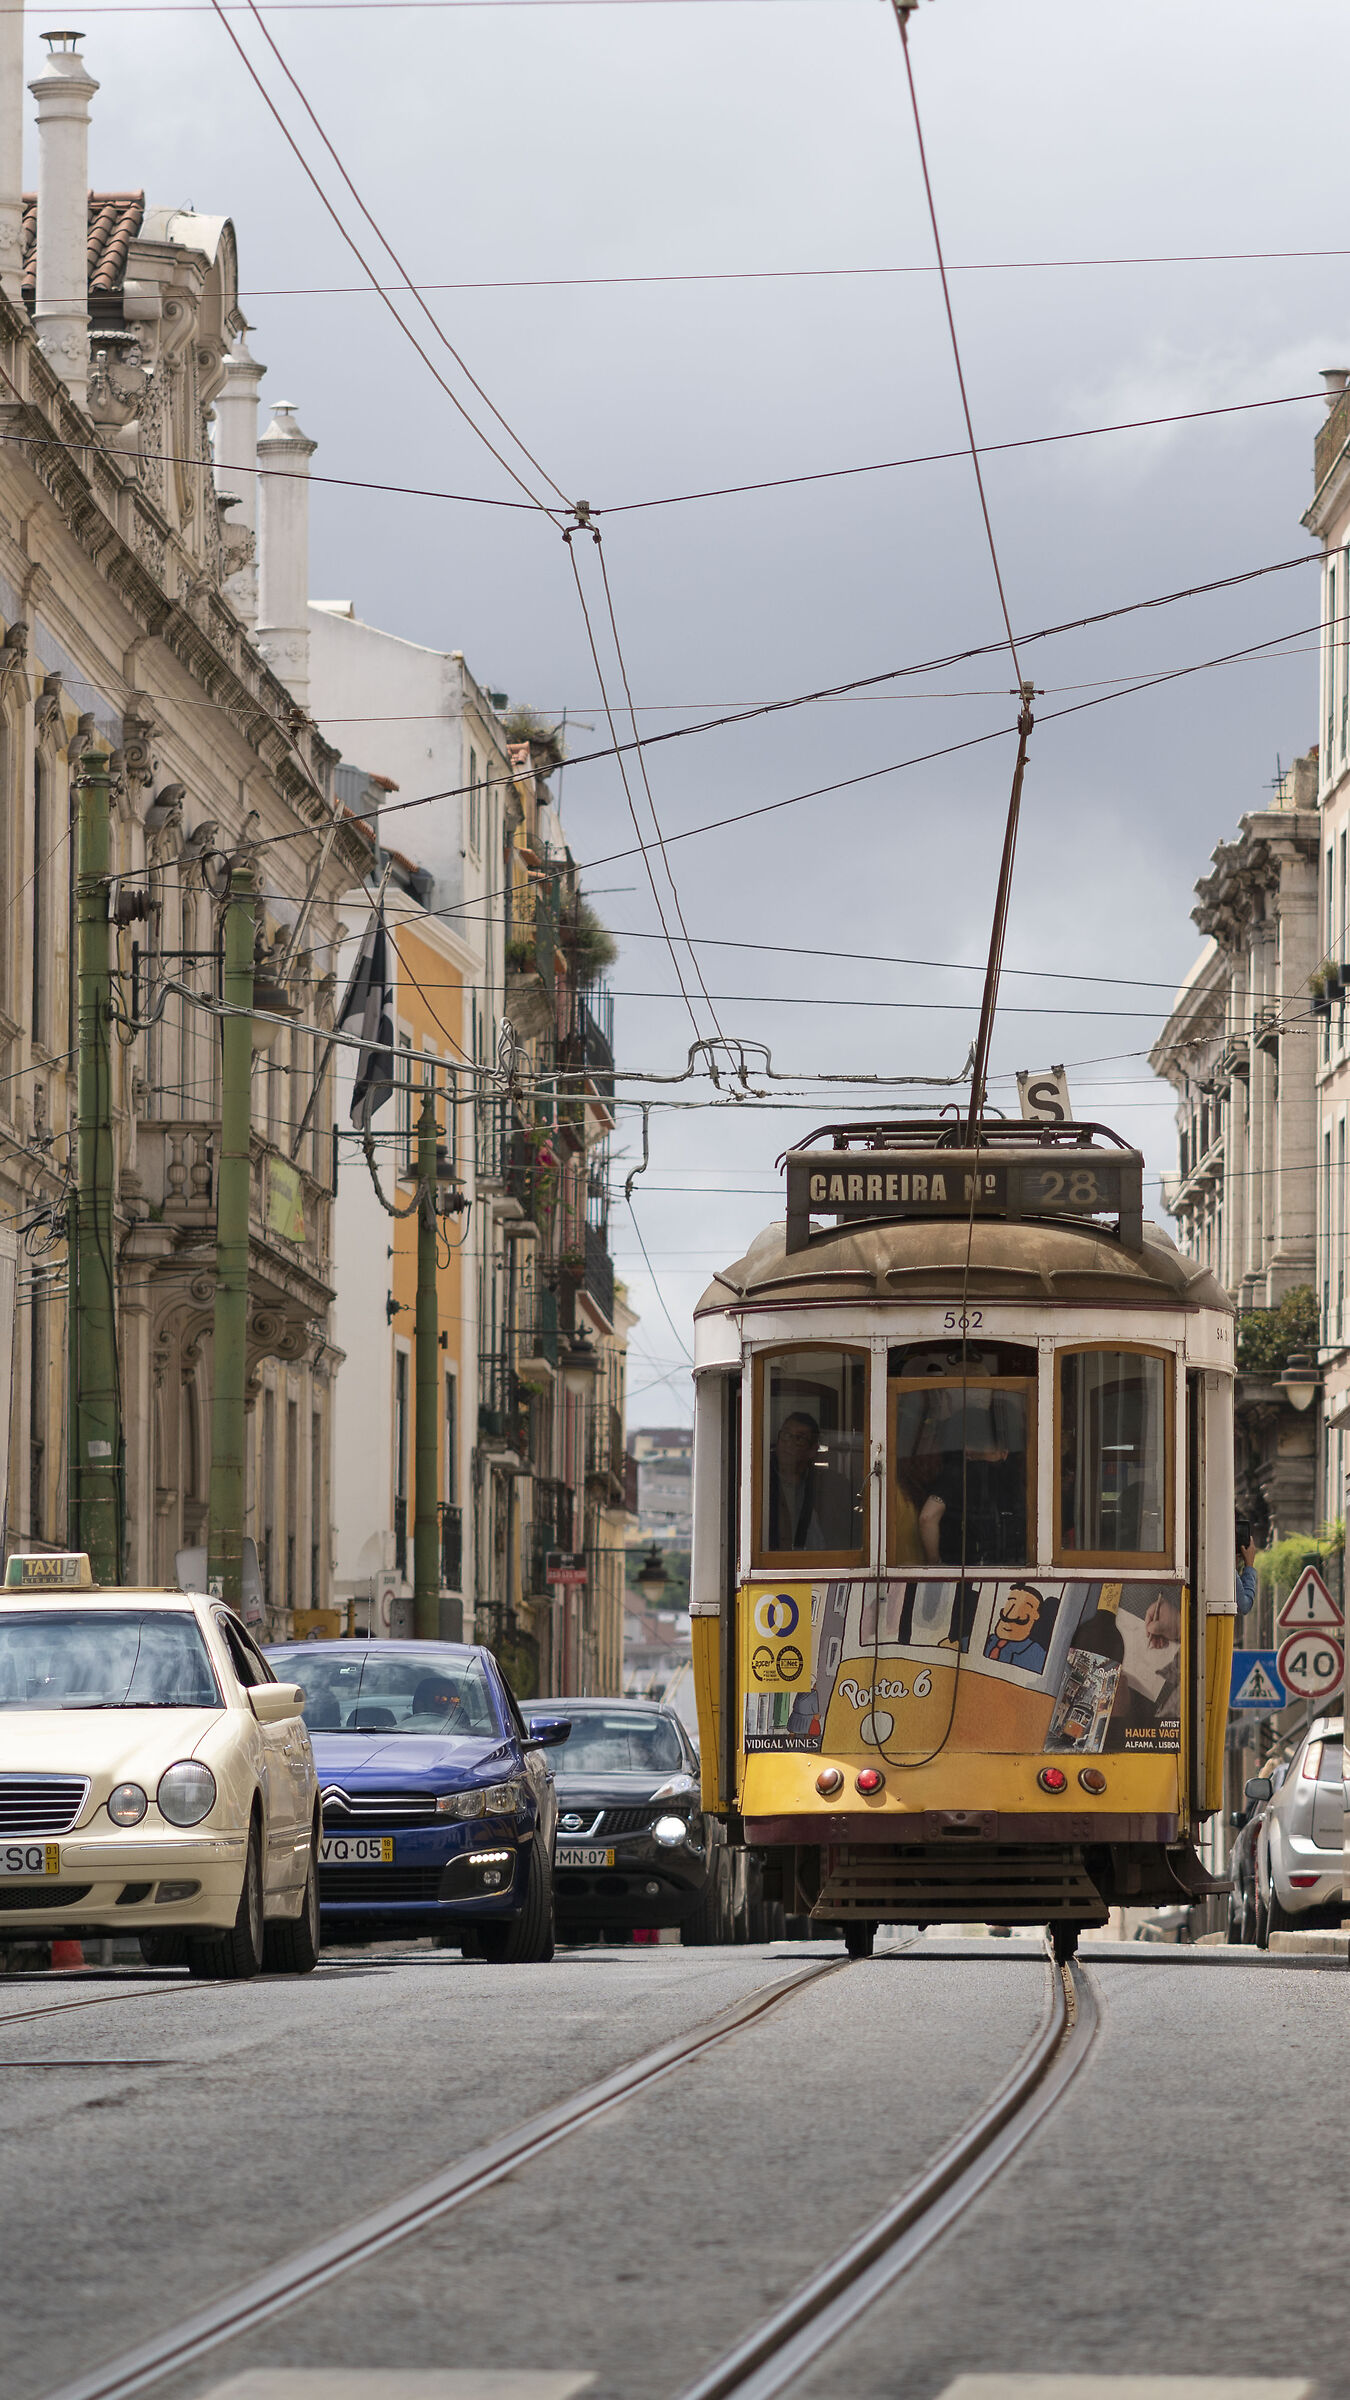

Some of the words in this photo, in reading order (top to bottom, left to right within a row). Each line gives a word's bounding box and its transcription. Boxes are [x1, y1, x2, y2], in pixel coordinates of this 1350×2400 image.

[1028, 1082, 1065, 1120] S
[810, 1174, 947, 1202] CARREIRA
[964, 1174, 996, 1202] Nº
[1039, 1169, 1098, 1206] 28
[944, 1311, 983, 1329] 562
[25, 1559, 62, 1576] TAXI
[1288, 1651, 1335, 1677] 40
[838, 1678, 909, 1710] Porta
[913, 1668, 932, 1698] 6
[1160, 1720, 1180, 1728] ARTIST
[1125, 1728, 1156, 1738] HAUKE
[1159, 1728, 1180, 1738] VAGT
[746, 1738, 784, 1749] VIDIGAL
[785, 1738, 819, 1748] WINES
[1158, 1741, 1180, 1749] LISBOA
[46, 1846, 57, 1855] 01
[47, 1862, 57, 1870] 11
